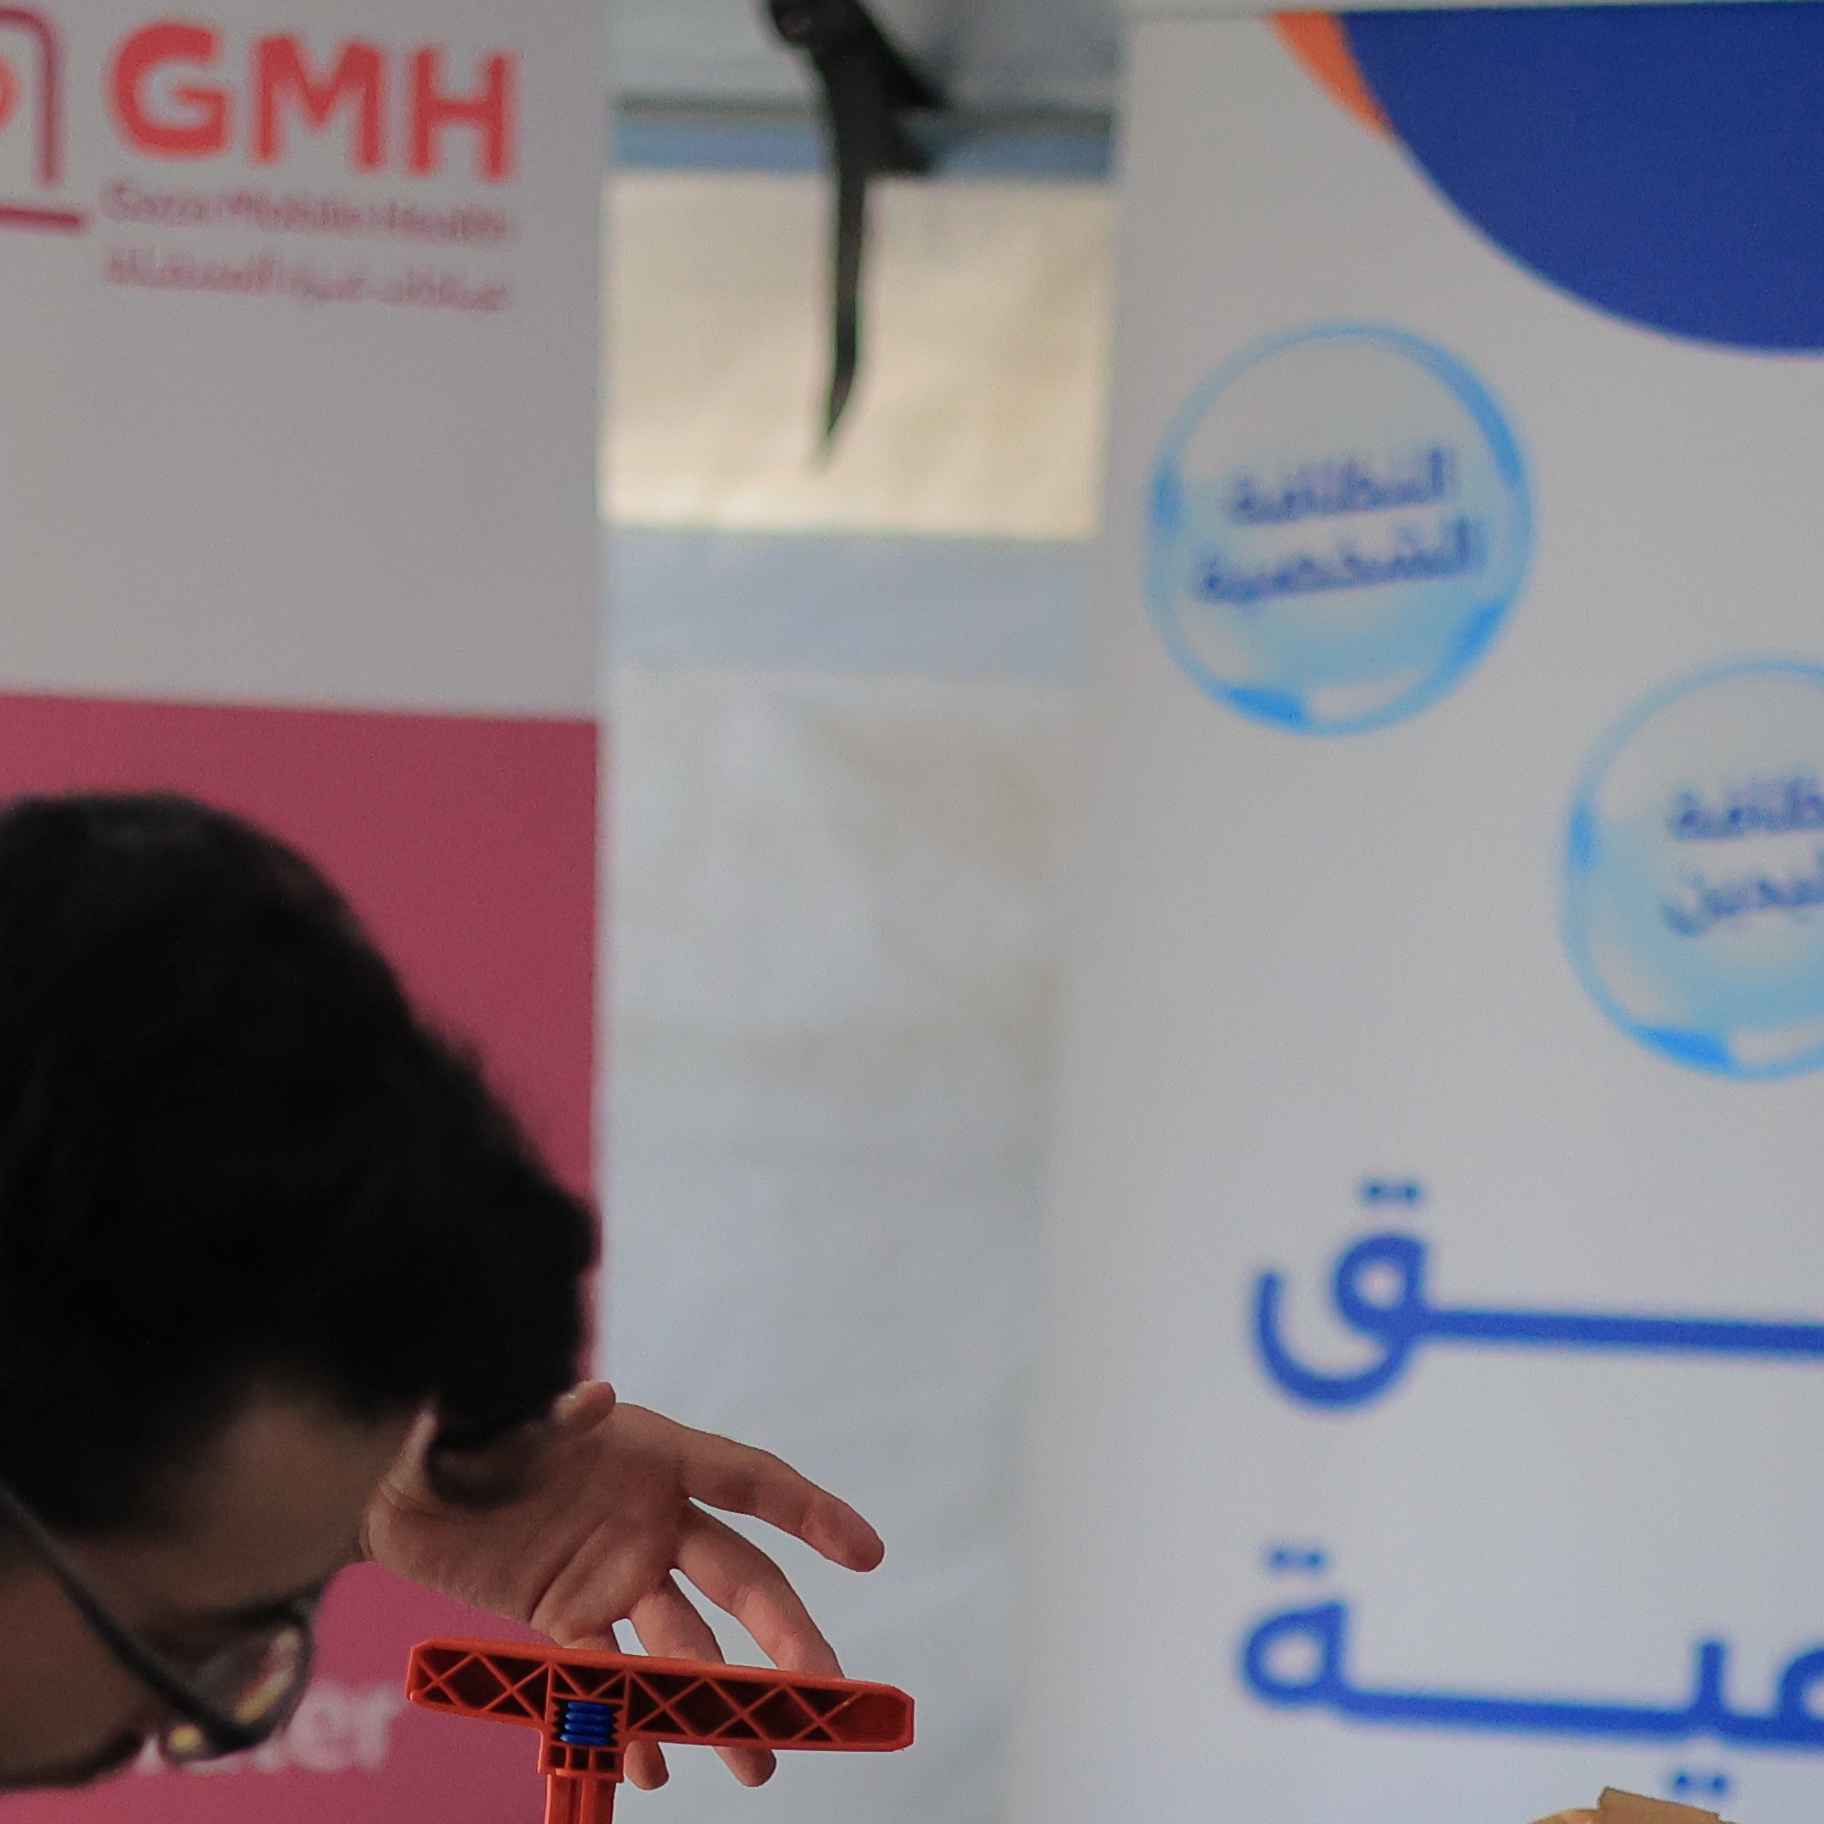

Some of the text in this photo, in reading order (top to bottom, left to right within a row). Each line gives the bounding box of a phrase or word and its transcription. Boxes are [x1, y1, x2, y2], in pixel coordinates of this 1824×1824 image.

[108, 22, 516, 181] GMH
[1226, 447, 1454, 526] النظافة
[1195, 518, 1483, 602] الشخصية
